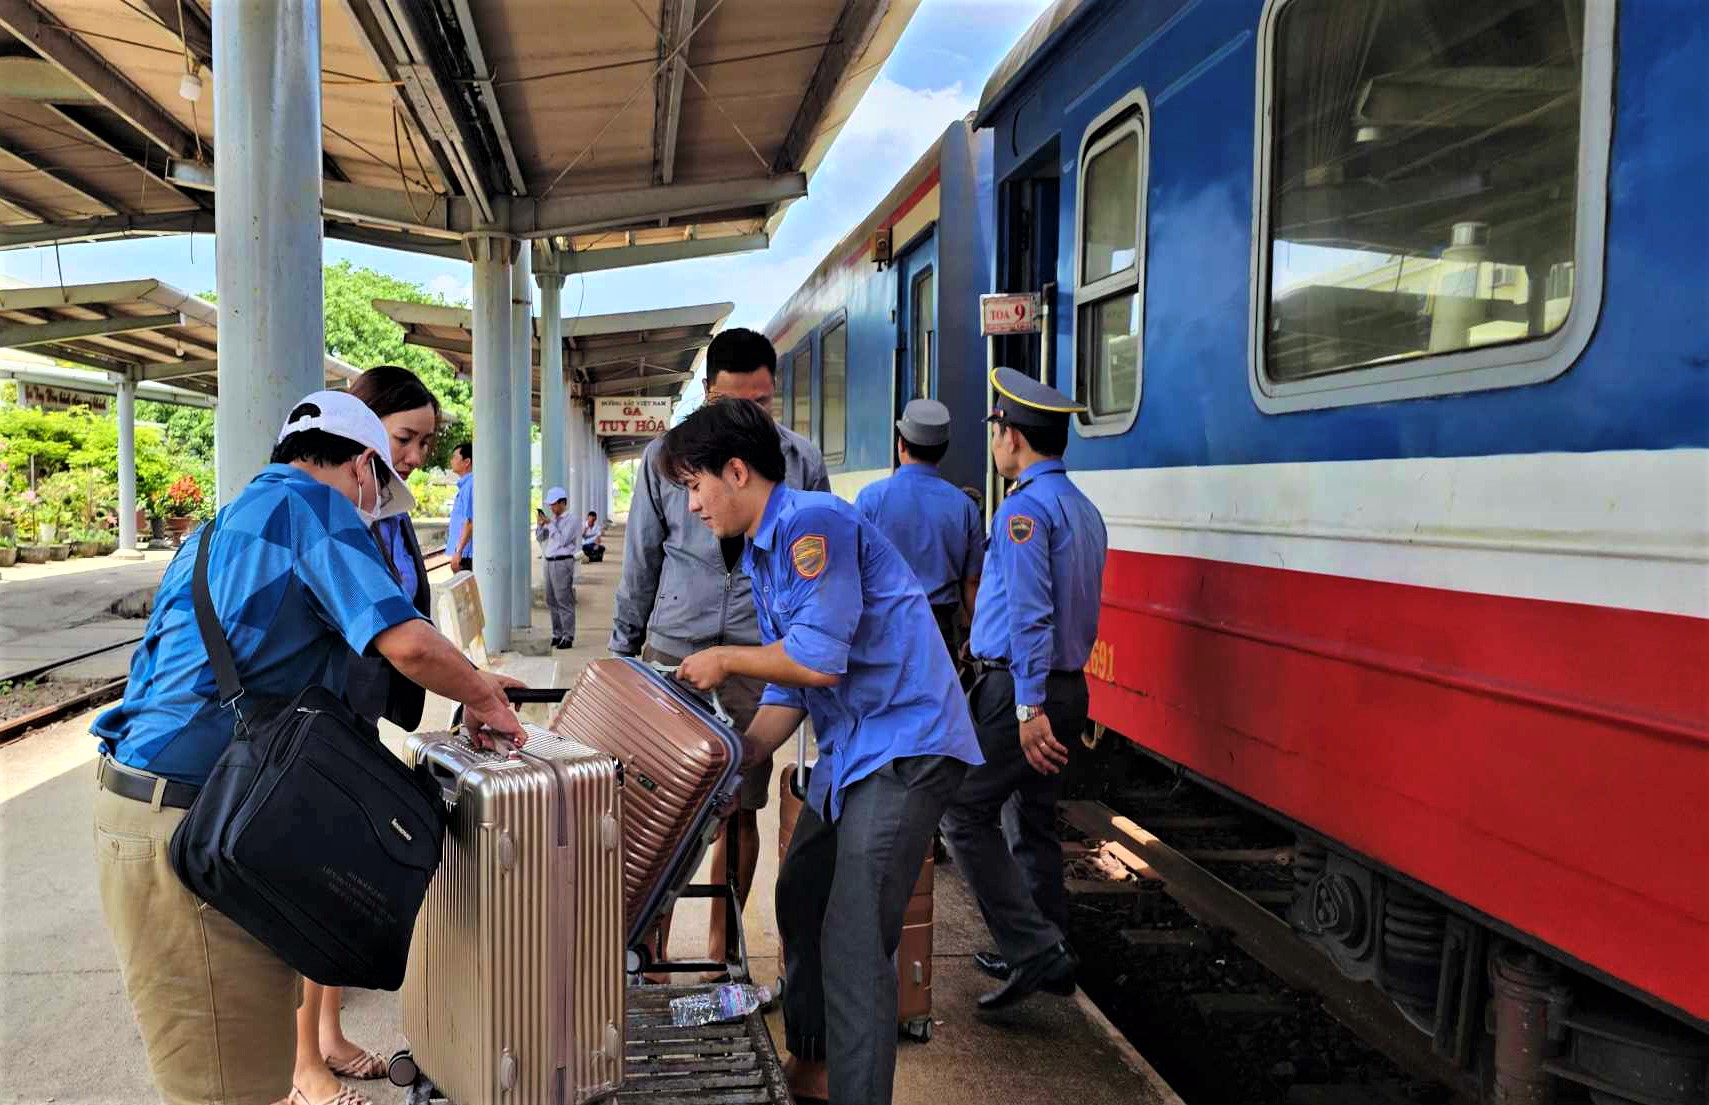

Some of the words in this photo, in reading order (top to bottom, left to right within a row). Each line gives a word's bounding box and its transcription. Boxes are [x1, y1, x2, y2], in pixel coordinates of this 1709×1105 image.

[991, 311, 1010, 321] TOA
[1014, 303, 1026, 323] 9
[623, 407, 643, 416] GA
[599, 420, 629, 432] TUY
[635, 416, 666, 432] HÒA
[1083, 640, 1115, 681] 691
